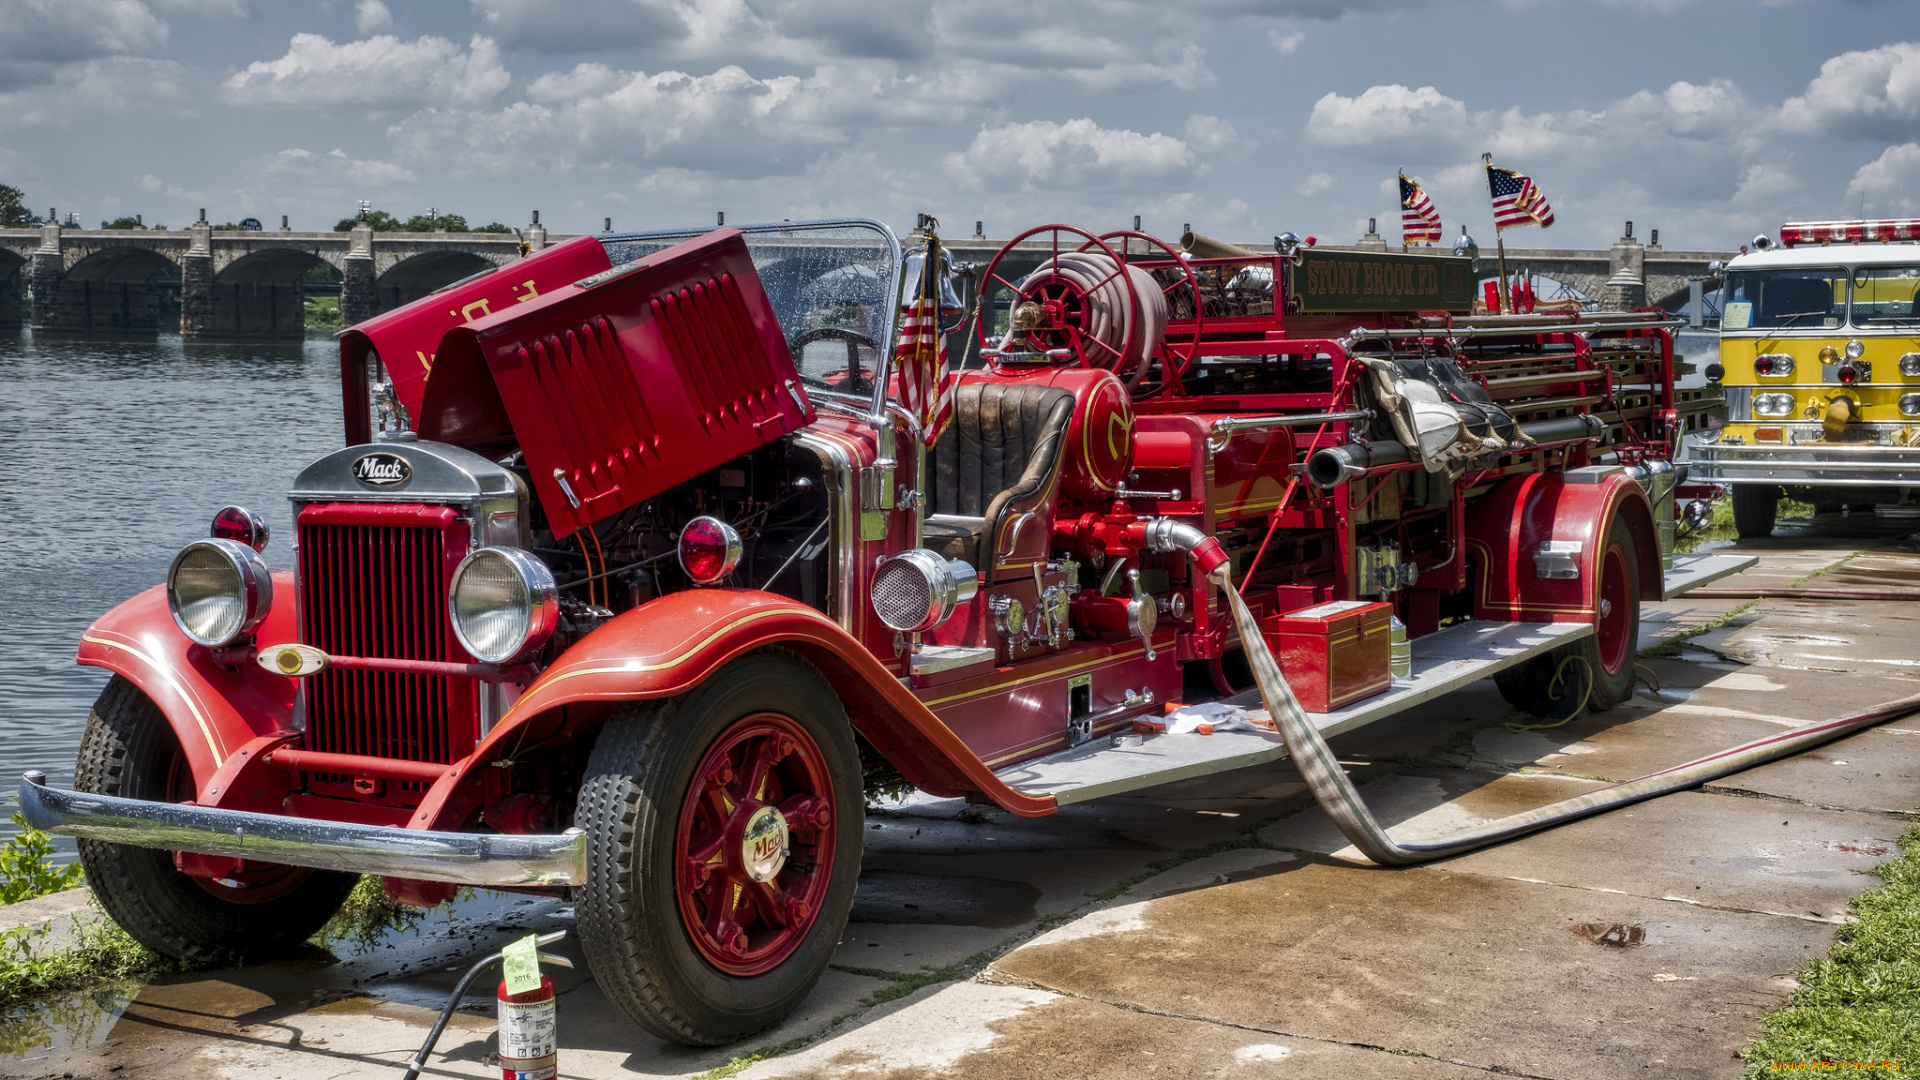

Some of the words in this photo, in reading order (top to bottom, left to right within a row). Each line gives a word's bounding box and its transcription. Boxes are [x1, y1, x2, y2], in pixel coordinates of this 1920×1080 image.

[1307, 259, 1360, 295] STONY
[1363, 262, 1415, 296] BROOK
[1418, 264, 1439, 296] F.D.
[357, 457, 404, 481] Mack
[514, 973, 531, 983] 2016
[508, 999, 555, 1010] INSTRUCTIONS
